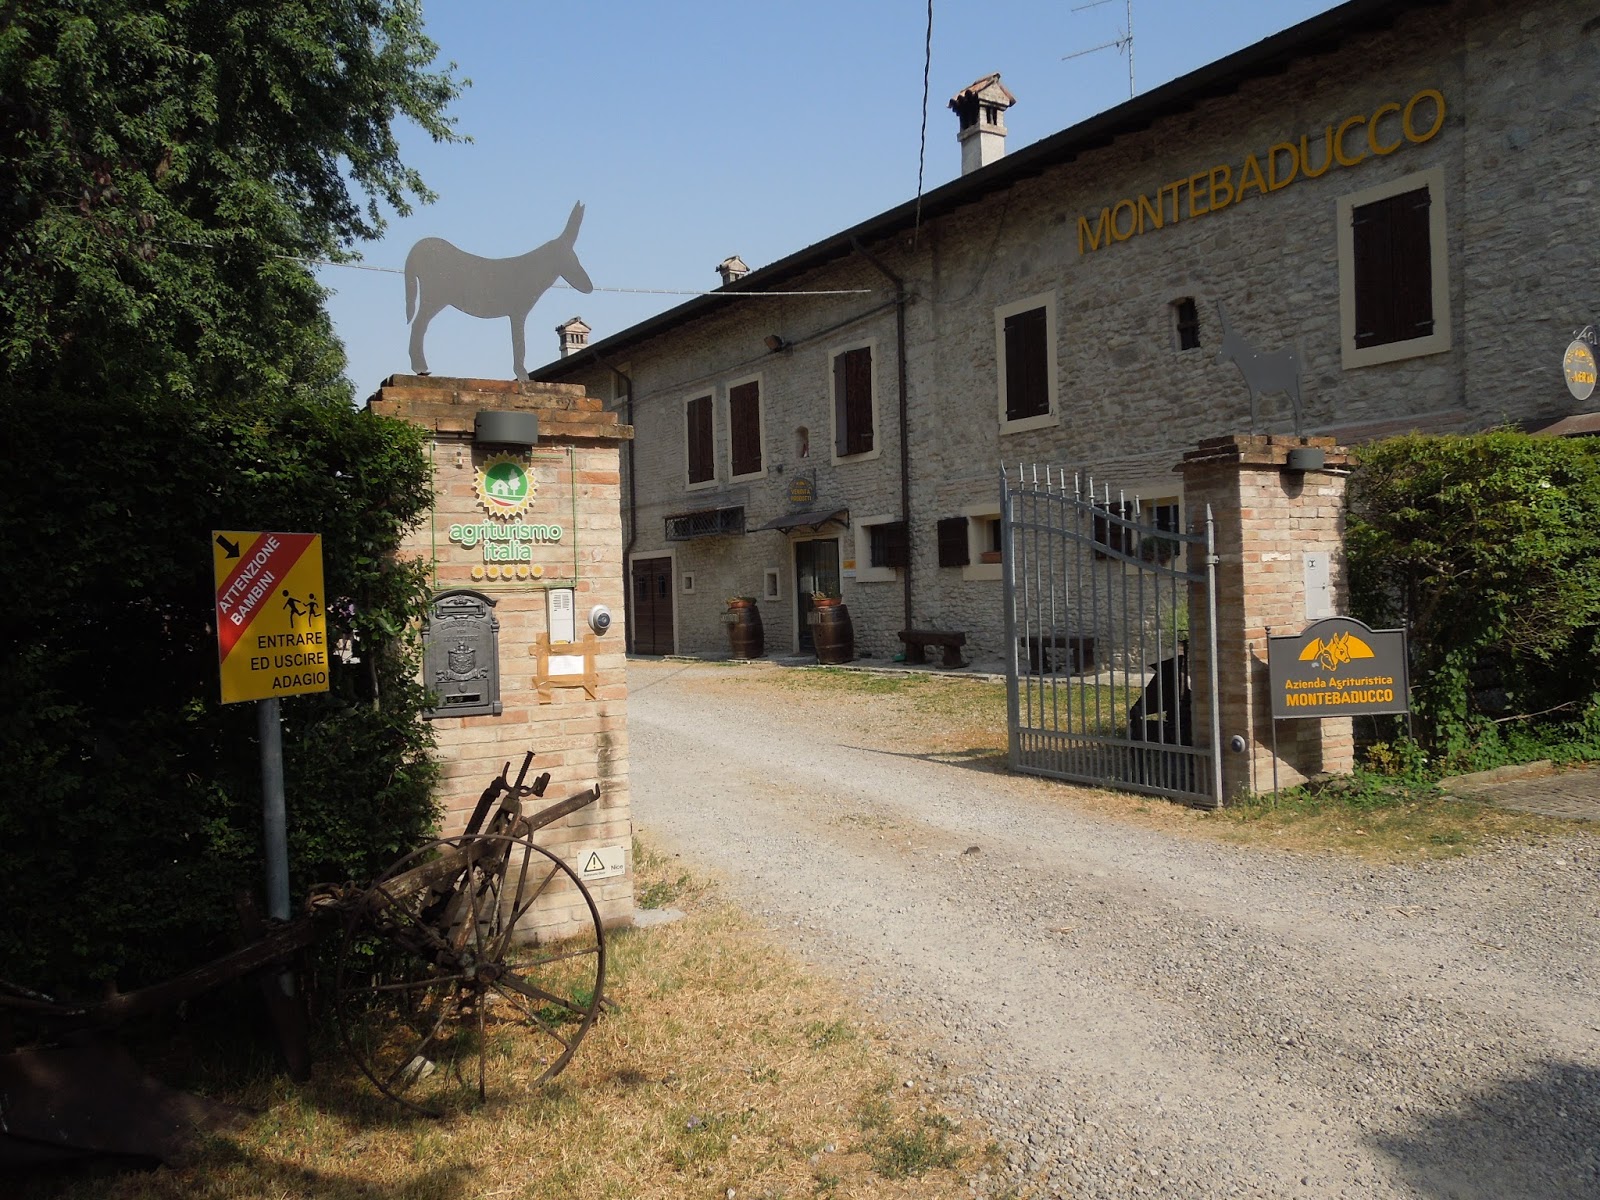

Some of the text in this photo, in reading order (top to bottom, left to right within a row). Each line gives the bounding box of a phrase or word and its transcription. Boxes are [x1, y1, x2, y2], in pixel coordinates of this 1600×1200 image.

[1076, 88, 1446, 256] MONTEBADUCCO
[450, 518, 562, 545] agriturismo
[484, 540, 532, 561] italia
[219, 536, 281, 614] ATTENZIONE
[230, 570, 275, 626] BAMBINI
[258, 632, 323, 649] ENTRARE
[251, 651, 325, 671] ED USCIRE
[272, 671, 326, 689] ADAGIO
[1285, 675, 1393, 690] Azienda Agrituristica
[1286, 688, 1394, 707] MONTEBADUCCO
